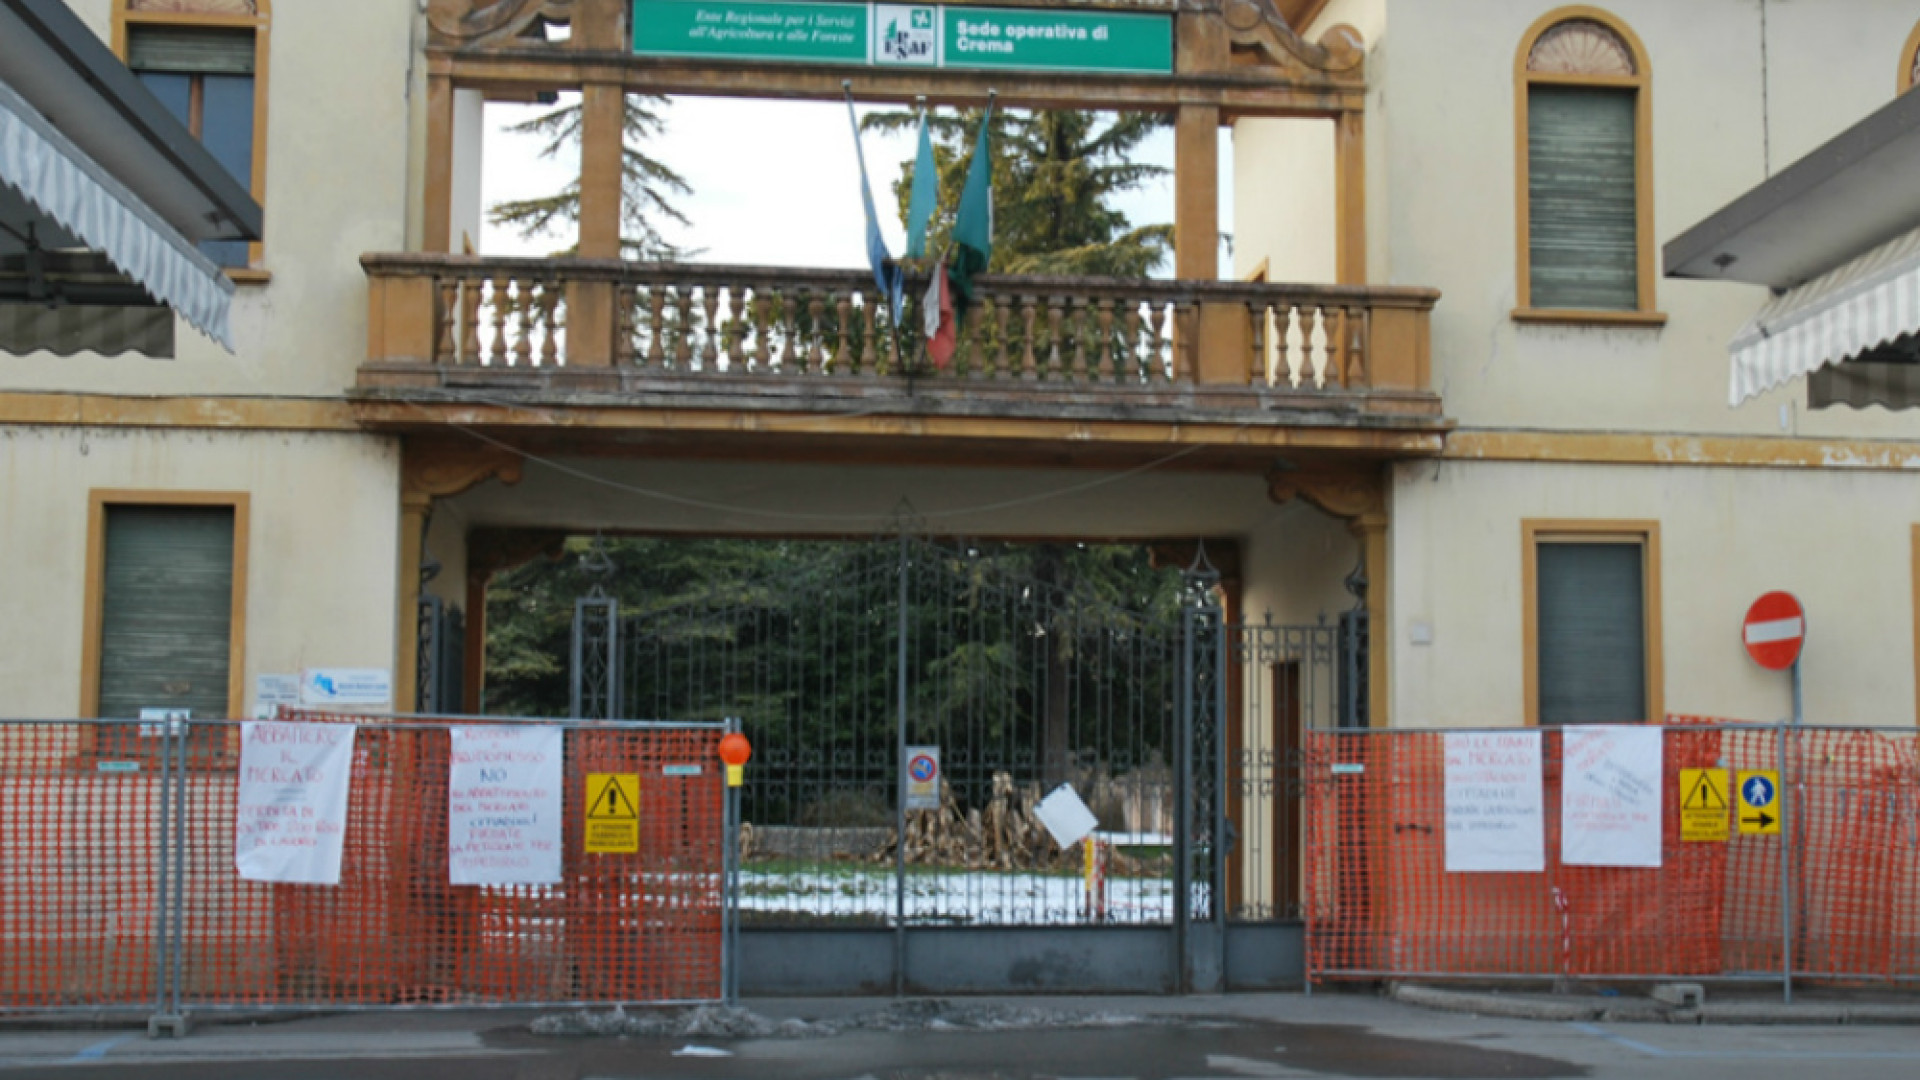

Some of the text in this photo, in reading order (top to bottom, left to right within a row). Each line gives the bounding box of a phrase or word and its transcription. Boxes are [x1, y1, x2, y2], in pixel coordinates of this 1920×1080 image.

[695, 9, 722, 22] Ente
[726, 10, 783, 25] Regionale
[784, 15, 805, 27] per
[816, 14, 855, 27] Servizi
[786, 29, 808, 41] alle
[811, 30, 855, 43] Foreste
[956, 19, 1109, 41] Sede operativa di
[956, 36, 1014, 54] Crema
[247, 765, 324, 784] MERCATO
[480, 768, 508, 783] NO
